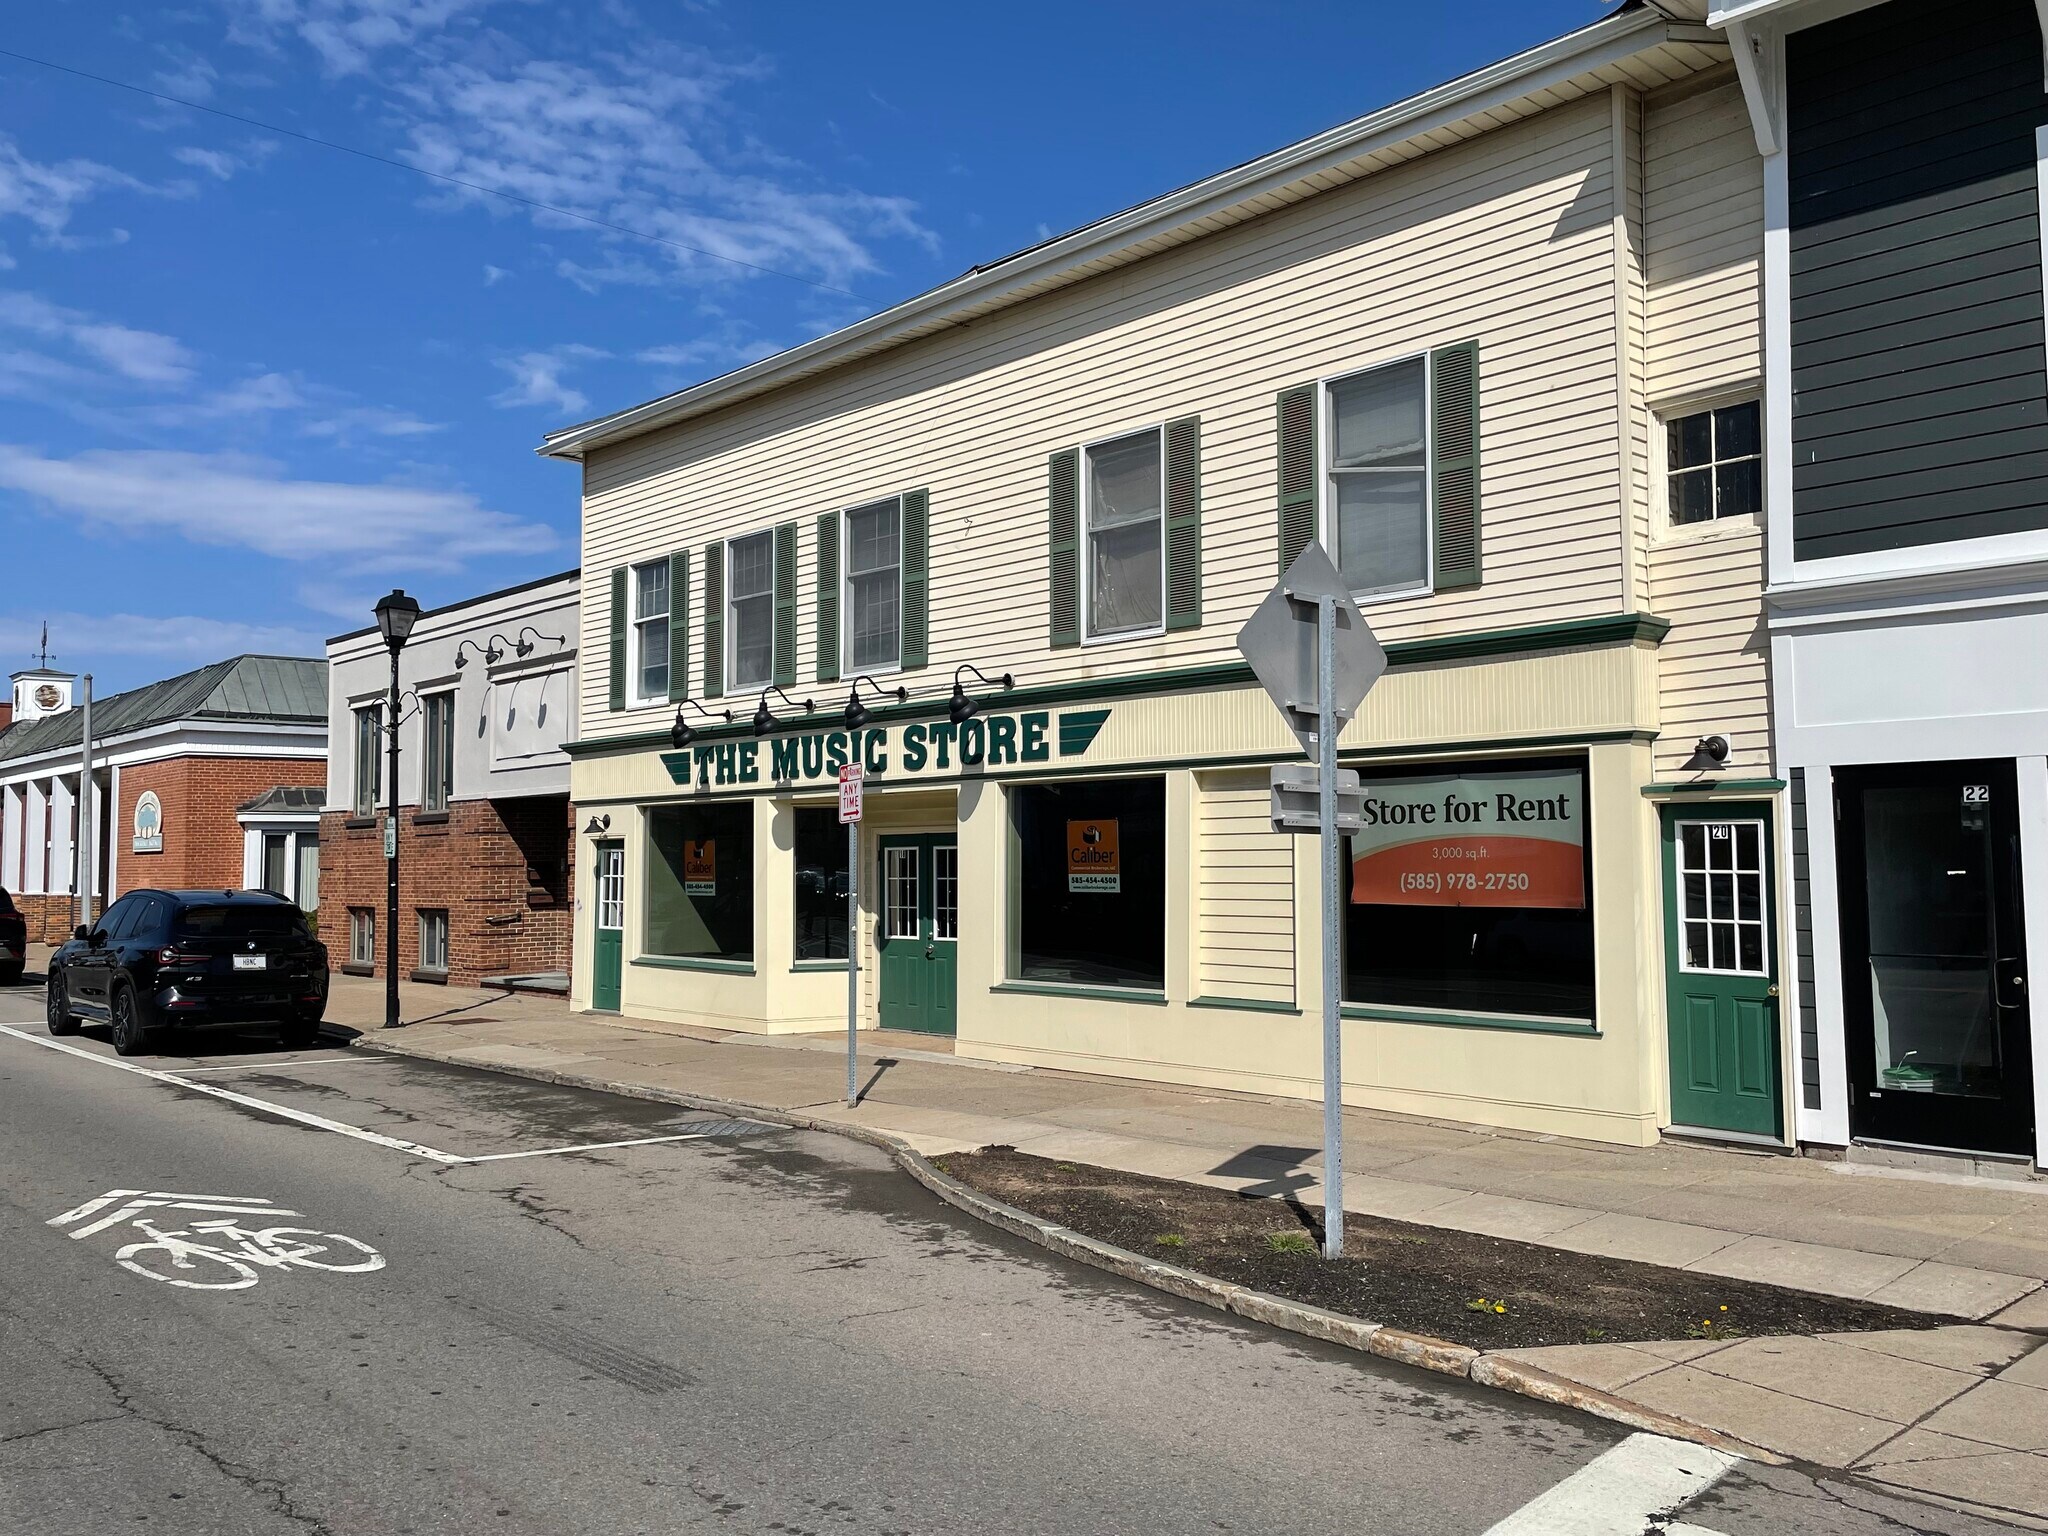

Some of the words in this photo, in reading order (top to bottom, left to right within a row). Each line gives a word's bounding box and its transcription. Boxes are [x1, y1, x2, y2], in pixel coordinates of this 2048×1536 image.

[693, 741, 759, 786] THE
[771, 728, 888, 781] MUSIC
[903, 711, 1050, 772] STORE
[844, 783, 858, 796] ANY
[1965, 786, 1988, 801] 22
[843, 795, 859, 809] TIME
[1363, 798, 1436, 825] Store
[1443, 794, 1488, 823] for
[1495, 793, 1571, 822] Rent
[1713, 825, 1727, 838] 20
[1072, 847, 1114, 863] Caliber
[1432, 847, 1463, 860] 3,000
[1465, 846, 1490, 861] sq.ft.
[686, 861, 713, 874] Caliber
[1071, 876, 1117, 884] 585-454-4500
[1400, 872, 1442, 893] (585)
[1447, 872, 1530, 891] 978-2750
